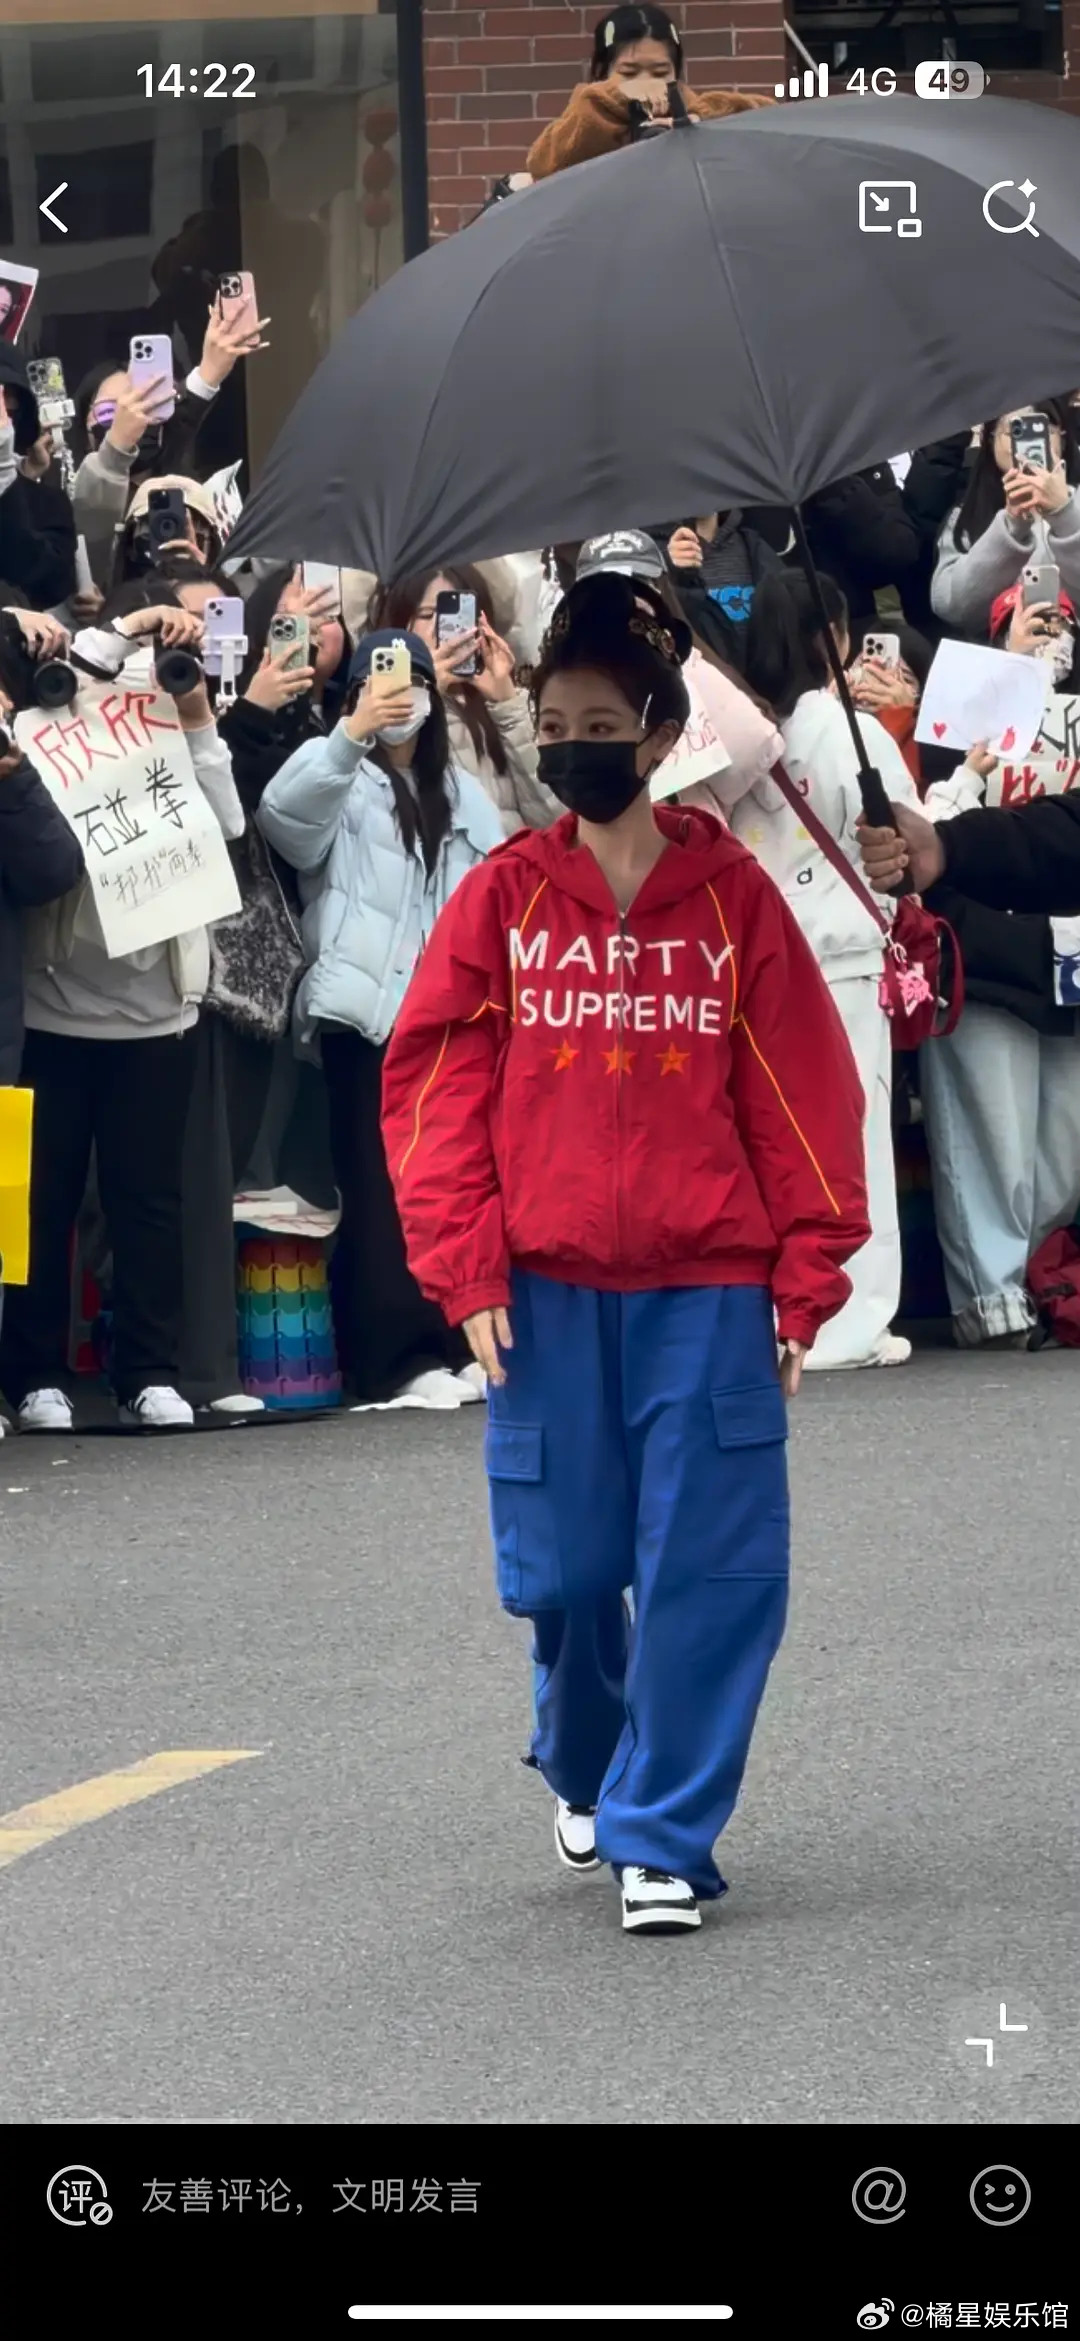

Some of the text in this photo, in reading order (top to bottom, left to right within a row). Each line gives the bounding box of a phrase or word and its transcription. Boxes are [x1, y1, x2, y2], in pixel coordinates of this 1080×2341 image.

[32, 692, 179, 789] 欣欣
[73, 757, 189, 857] 碰拳
[509, 927, 735, 982] MARTY
[519, 987, 723, 1036] SUPREME
